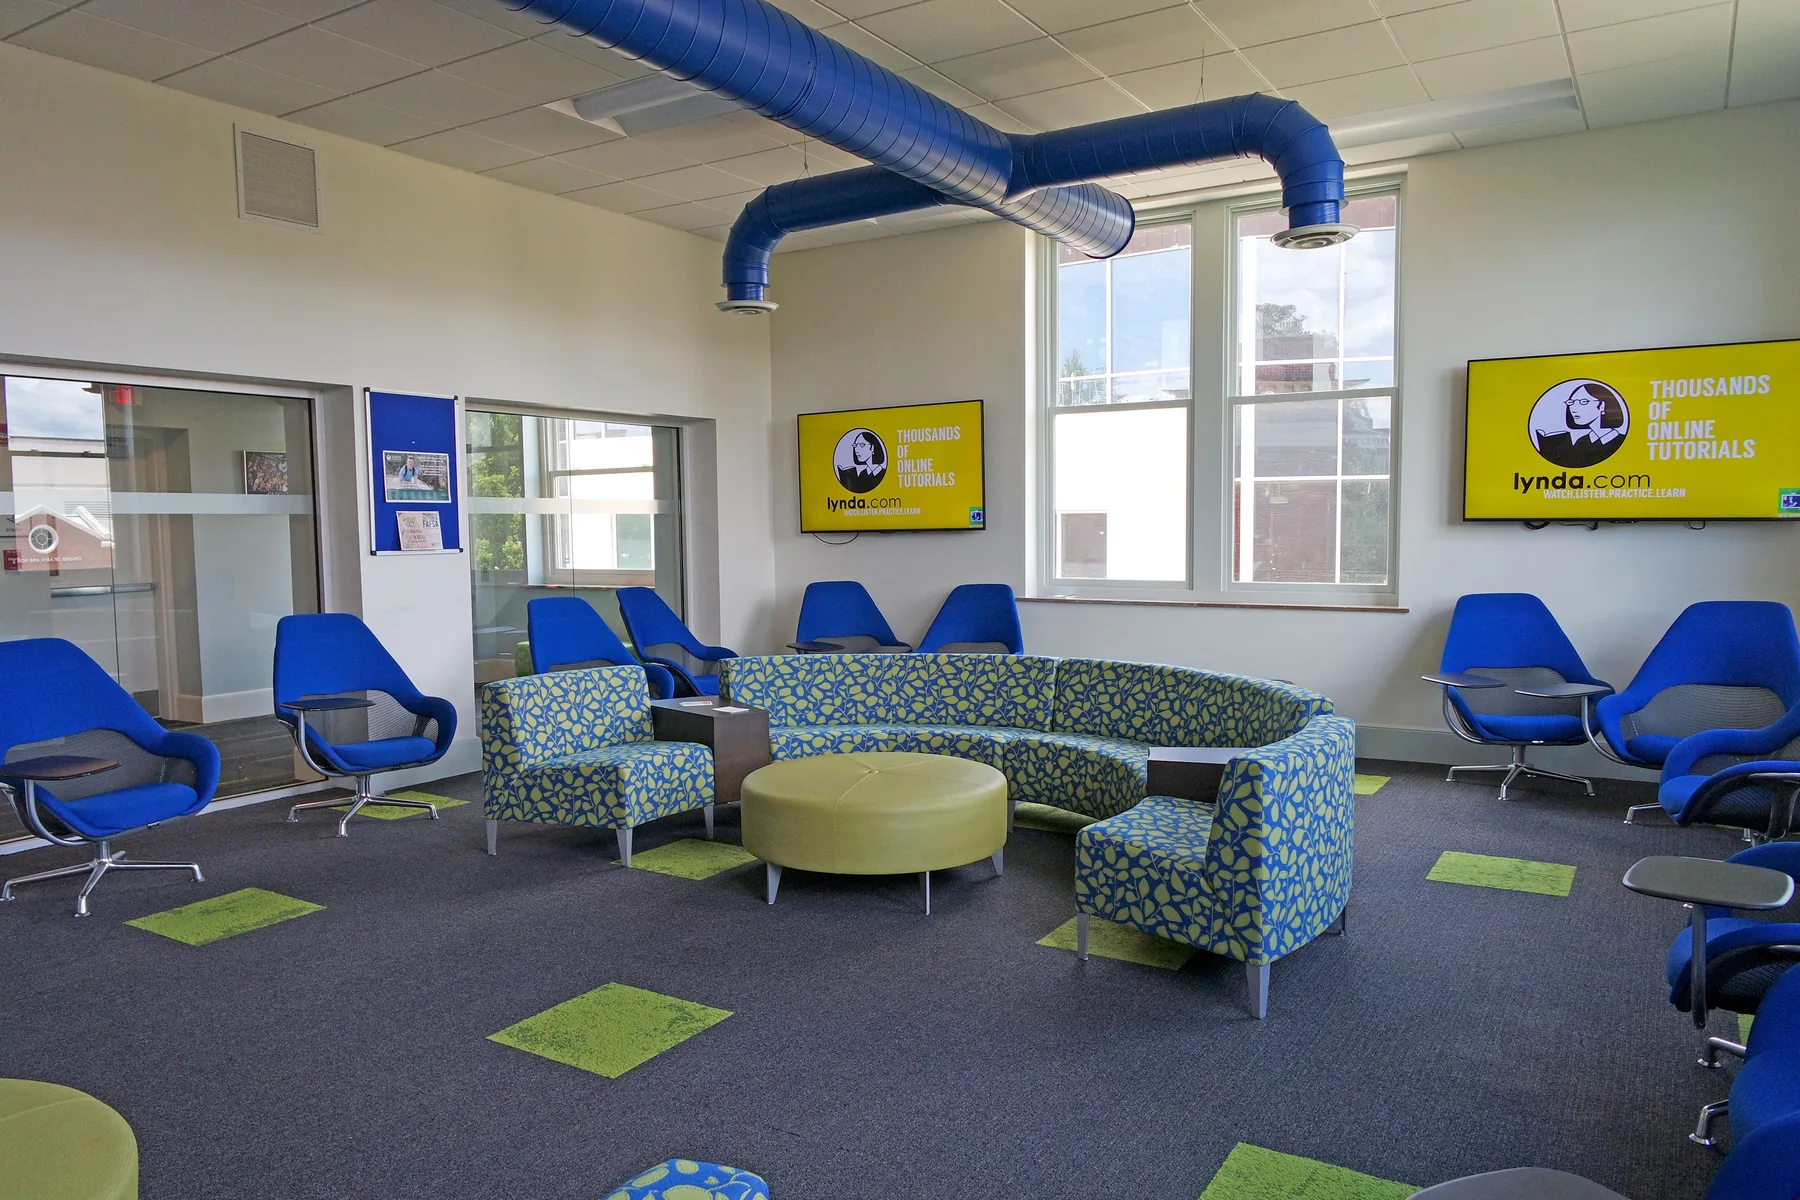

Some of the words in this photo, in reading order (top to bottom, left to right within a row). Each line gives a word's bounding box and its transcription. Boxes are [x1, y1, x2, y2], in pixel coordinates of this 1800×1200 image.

[1649, 375, 1771, 399] THOUSANDS
[1648, 401, 1671, 420] OF
[896, 426, 961, 443] THOUSANDS
[1647, 420, 1716, 441] ONLINE
[897, 445, 909, 459] OF
[1646, 439, 1756, 461] TUTORIALS
[897, 458, 933, 473] ONLINE
[897, 472, 955, 488] TUTORIALS
[1513, 471, 1651, 494] lynda.com
[827, 497, 902, 513] lynda.com
